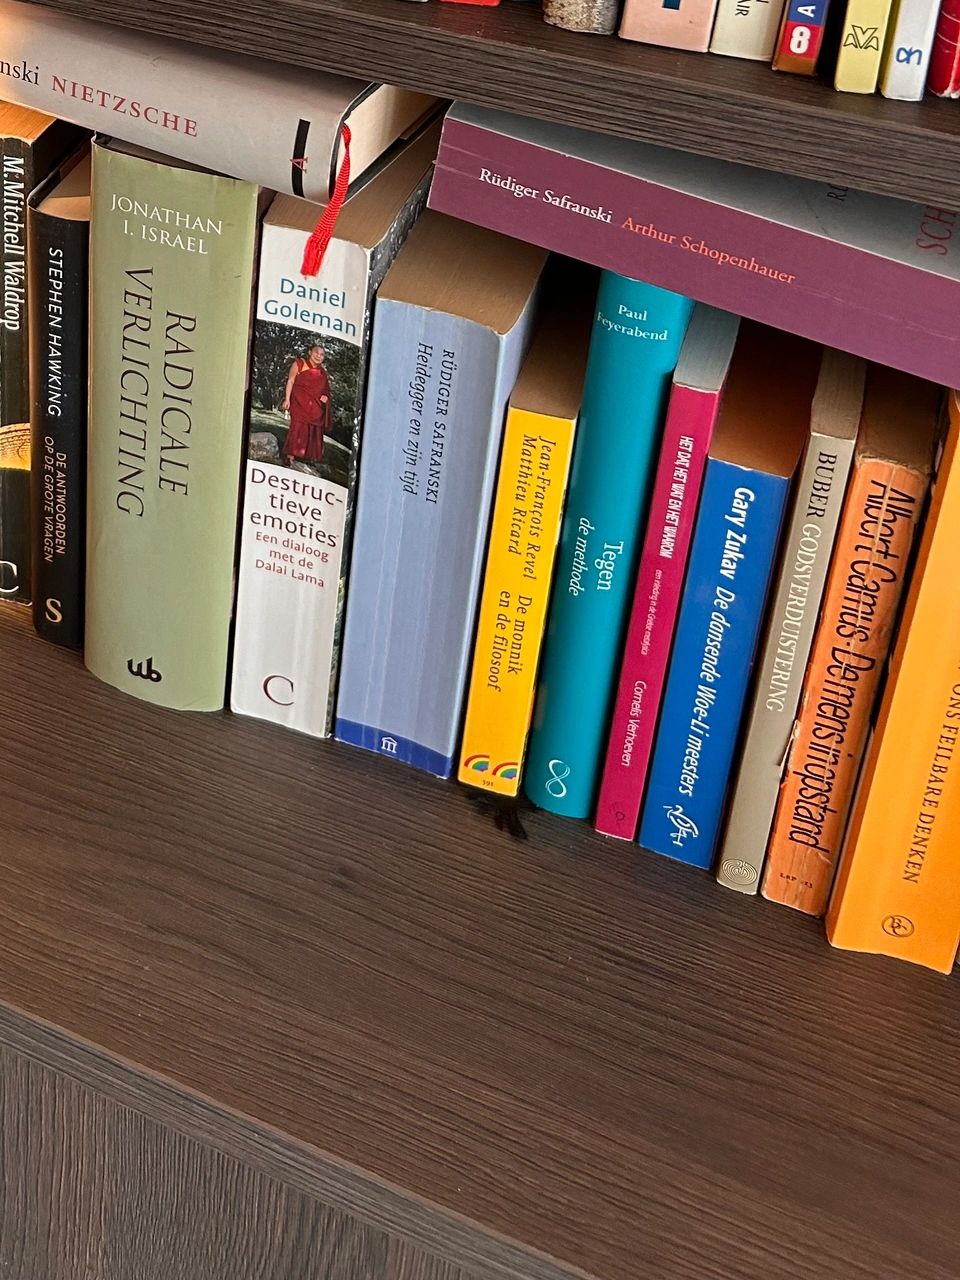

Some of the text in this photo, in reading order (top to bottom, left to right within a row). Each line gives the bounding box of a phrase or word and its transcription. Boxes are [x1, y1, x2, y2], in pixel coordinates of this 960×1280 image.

[52, 74, 198, 137] NIETZSCHE
[110, 193, 223, 236] JONATHAN
[141, 226, 208, 254] ISRAEL
[479, 167, 796, 284] Rüdiger Safranski Arthur Schopenhauer
[0, 259, 25, 332] Waldrop
[264, 299, 356, 336] Goleman
[280, 278, 346, 308] Daniel
[618, 304, 648, 321] Paul
[47, 247, 64, 417] STEPHEN HAWKING
[117, 266, 154, 518] VERLICHTING
[159, 310, 197, 497] RADICALE
[409, 342, 433, 416] Heidegger
[426, 349, 455, 504] RÜDIGER SAFRANSKI
[251, 468, 343, 506] Destruc-
[269, 493, 322, 521] tieve
[250, 511, 337, 547] emoties
[282, 536, 329, 563] dialoog
[291, 569, 325, 588] Lama
[569, 536, 591, 596] methode
[594, 541, 624, 591] Tegen
[766, 451, 837, 712] BUBER GODSVERDUISTERING
[486, 632, 506, 693] filosoof
[507, 618, 527, 674] monnik
[678, 487, 755, 797] Gary Zukav De dansende Woe-Li meesters
[902, 725, 959, 884] FEILBARE DENKEN
